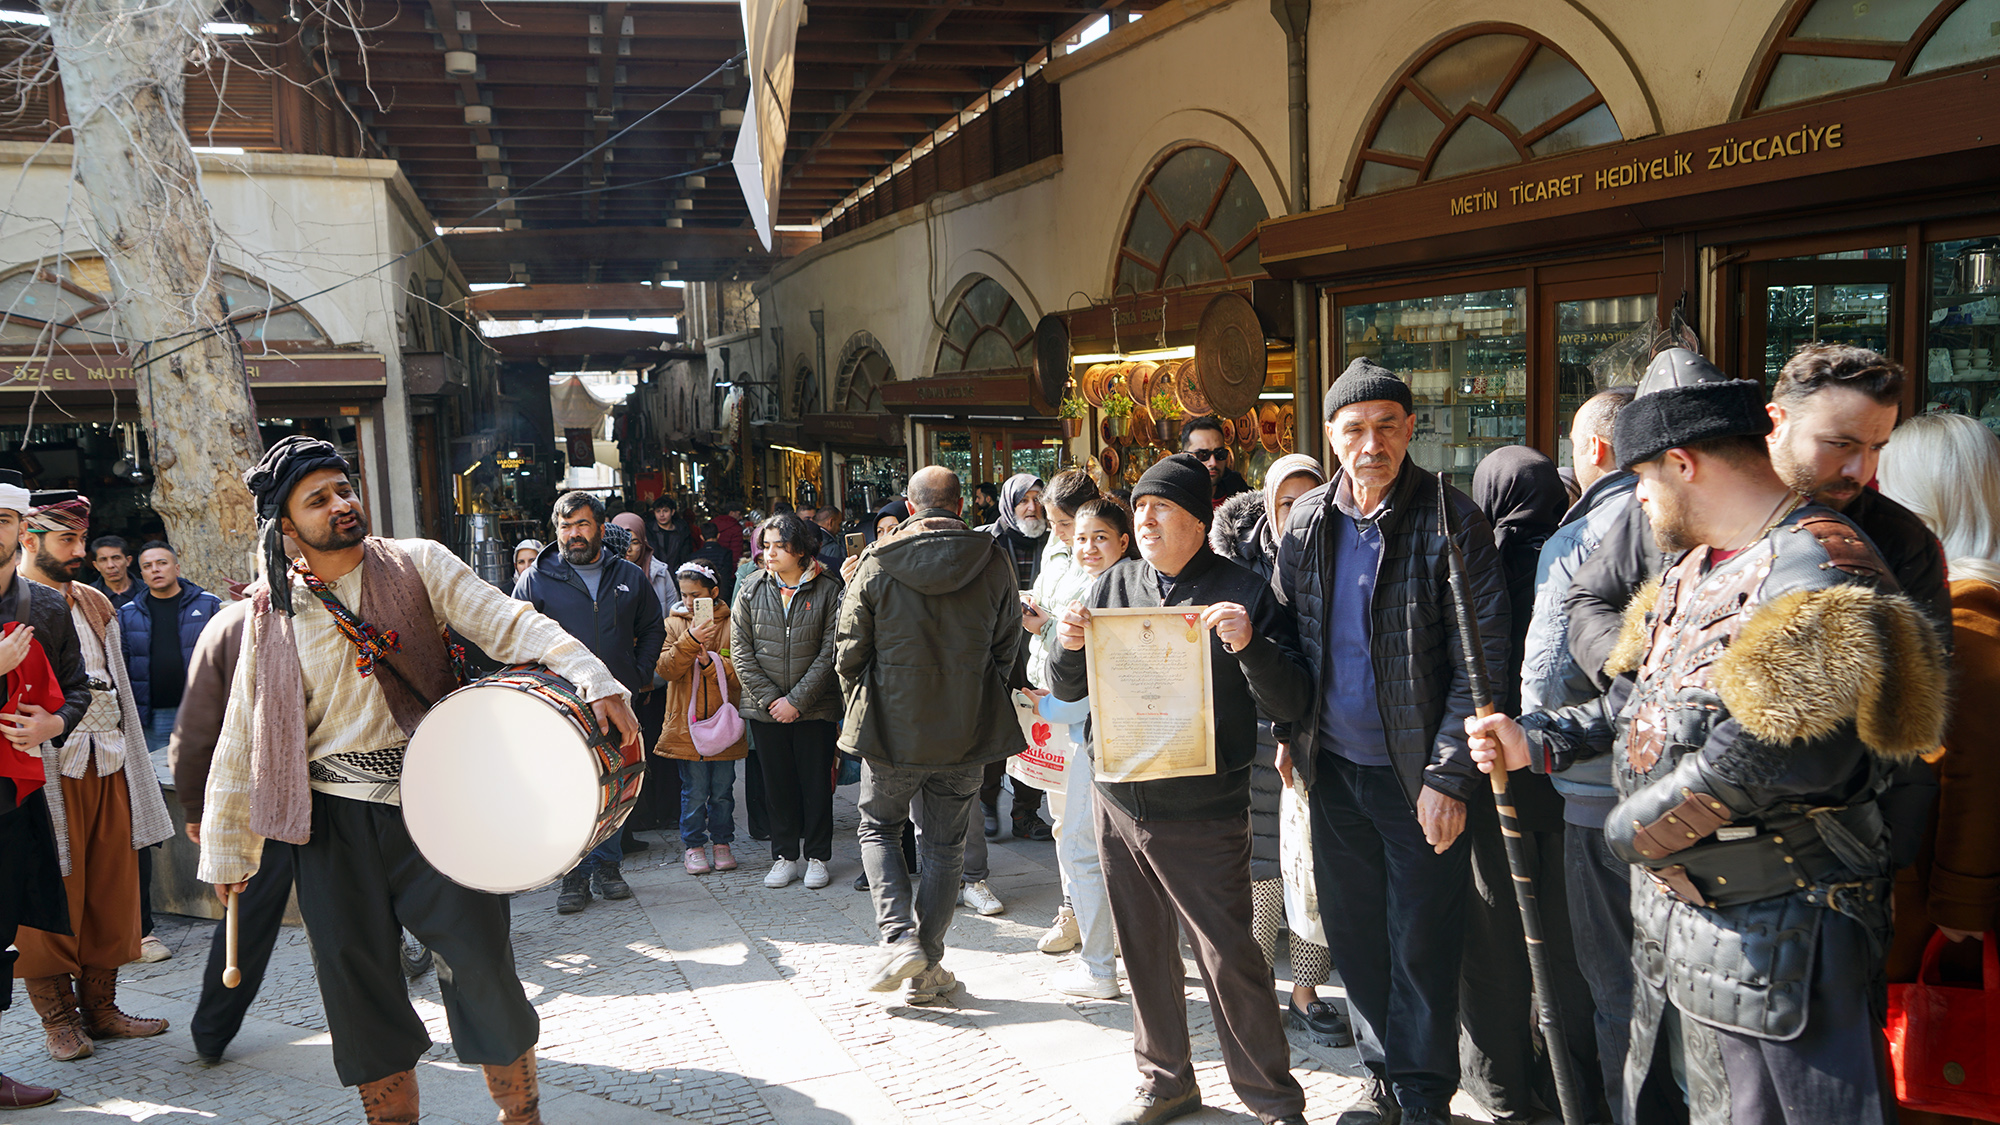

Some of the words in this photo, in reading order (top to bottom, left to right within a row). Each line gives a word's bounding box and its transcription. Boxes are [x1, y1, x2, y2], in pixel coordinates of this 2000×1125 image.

[1451, 187, 1498, 216] METİN
[1509, 173, 1584, 206] TİCARET
[1595, 149, 1694, 191] HEDİYELİK
[1707, 123, 1843, 170] ZÜCCACİYE
[87, 367, 135, 382] MUTF
[1023, 744, 1065, 764] kıkom
